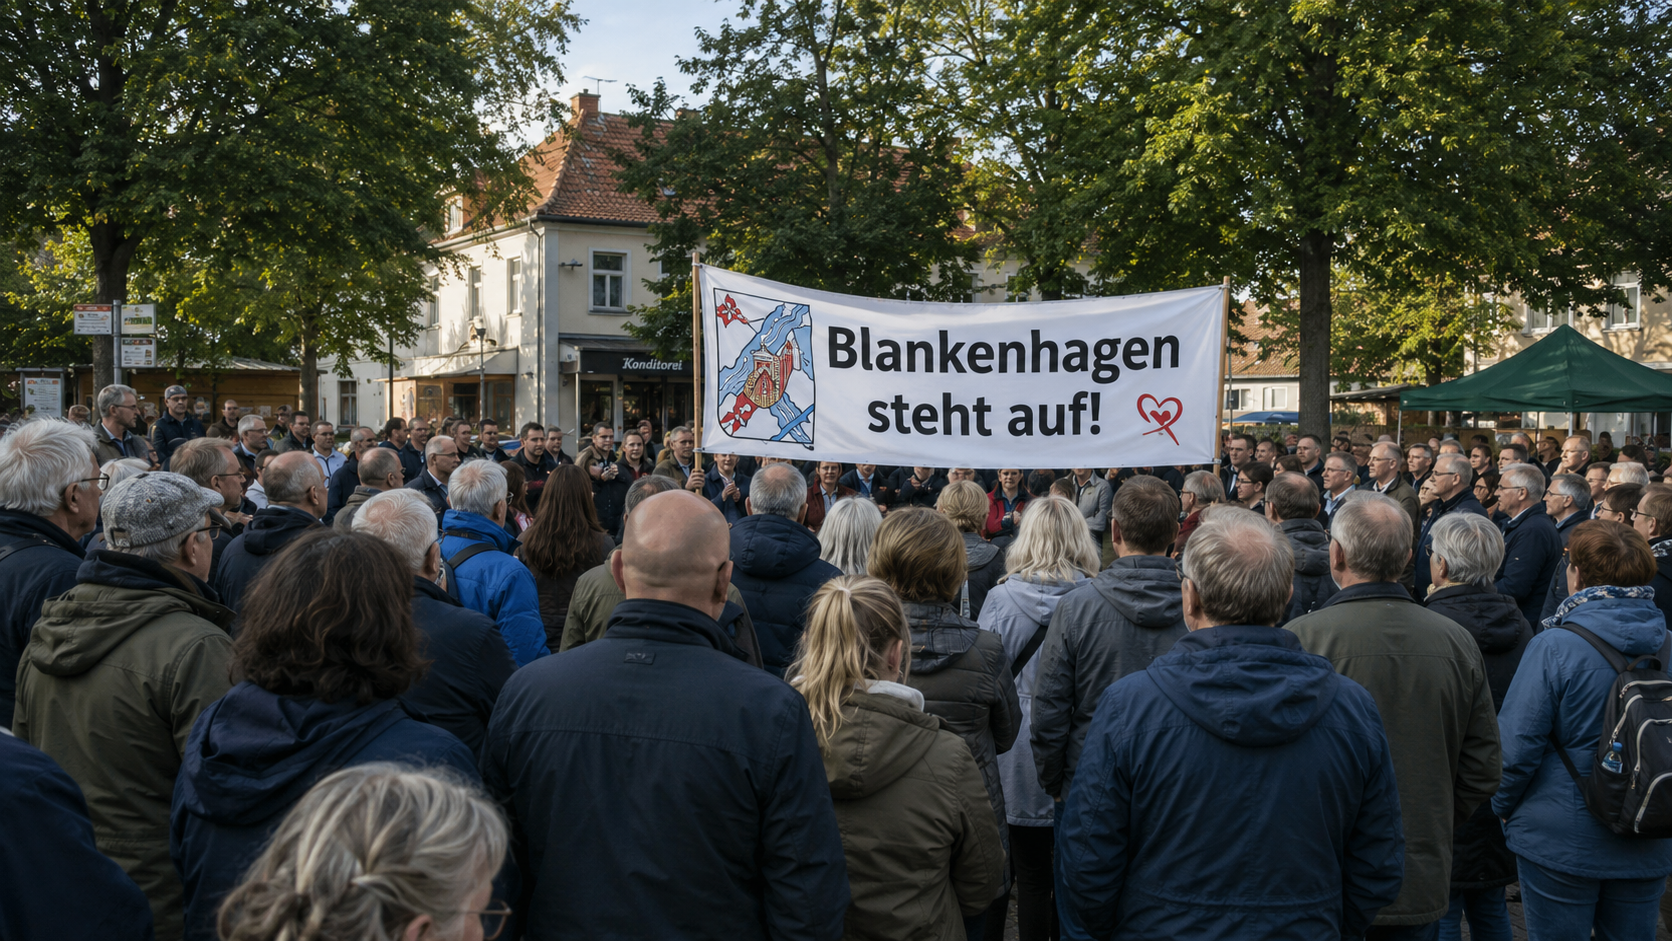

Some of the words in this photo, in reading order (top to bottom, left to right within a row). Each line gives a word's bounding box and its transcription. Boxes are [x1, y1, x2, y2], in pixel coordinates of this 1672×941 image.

[623, 357, 683, 371] Konditorei
[828, 326, 1179, 383] Blankenhagen
[868, 392, 992, 436] steht
[1008, 391, 1101, 436] auf!
